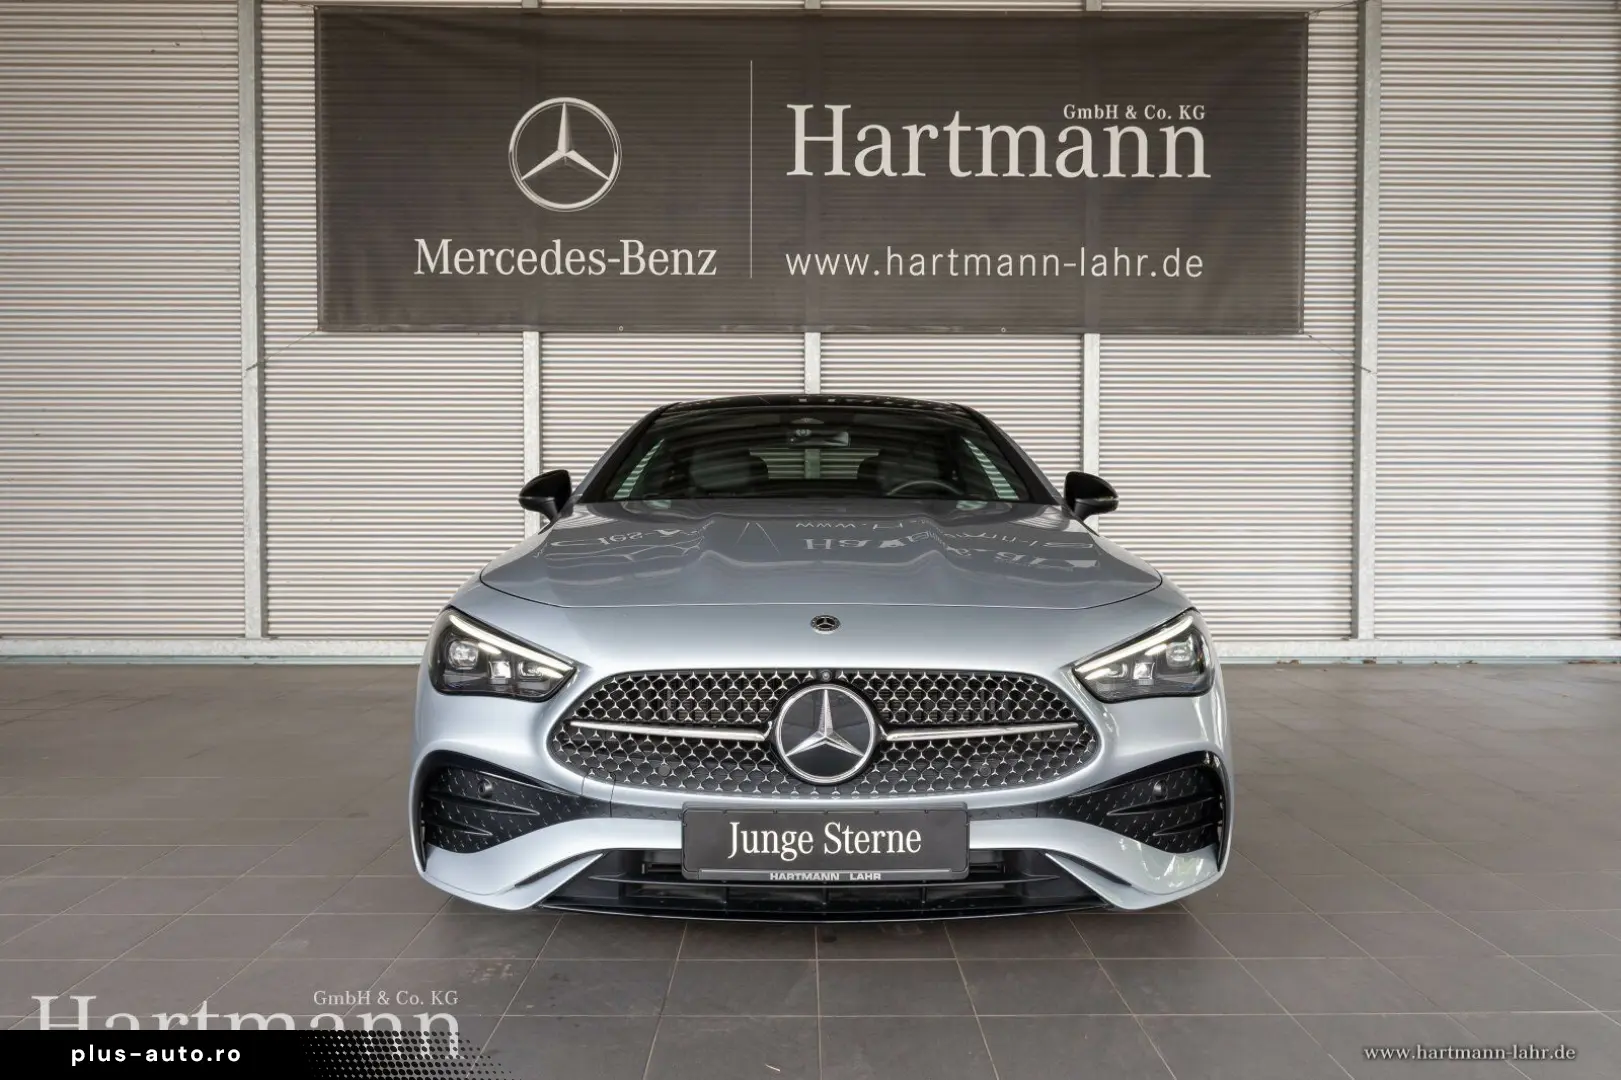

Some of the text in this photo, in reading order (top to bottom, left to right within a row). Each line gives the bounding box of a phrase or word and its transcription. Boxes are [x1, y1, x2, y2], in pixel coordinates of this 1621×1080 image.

[1063, 104, 1206, 121] GmbH & Co. KG
[786, 103, 1211, 179] Hartmann
[413, 238, 718, 276] Mercedes-Benz
[785, 246, 1204, 278] www.hartmann-lahr.de
[727, 821, 922, 862] Junge Sterne
[769, 872, 882, 881] HARTMANN LAHR
